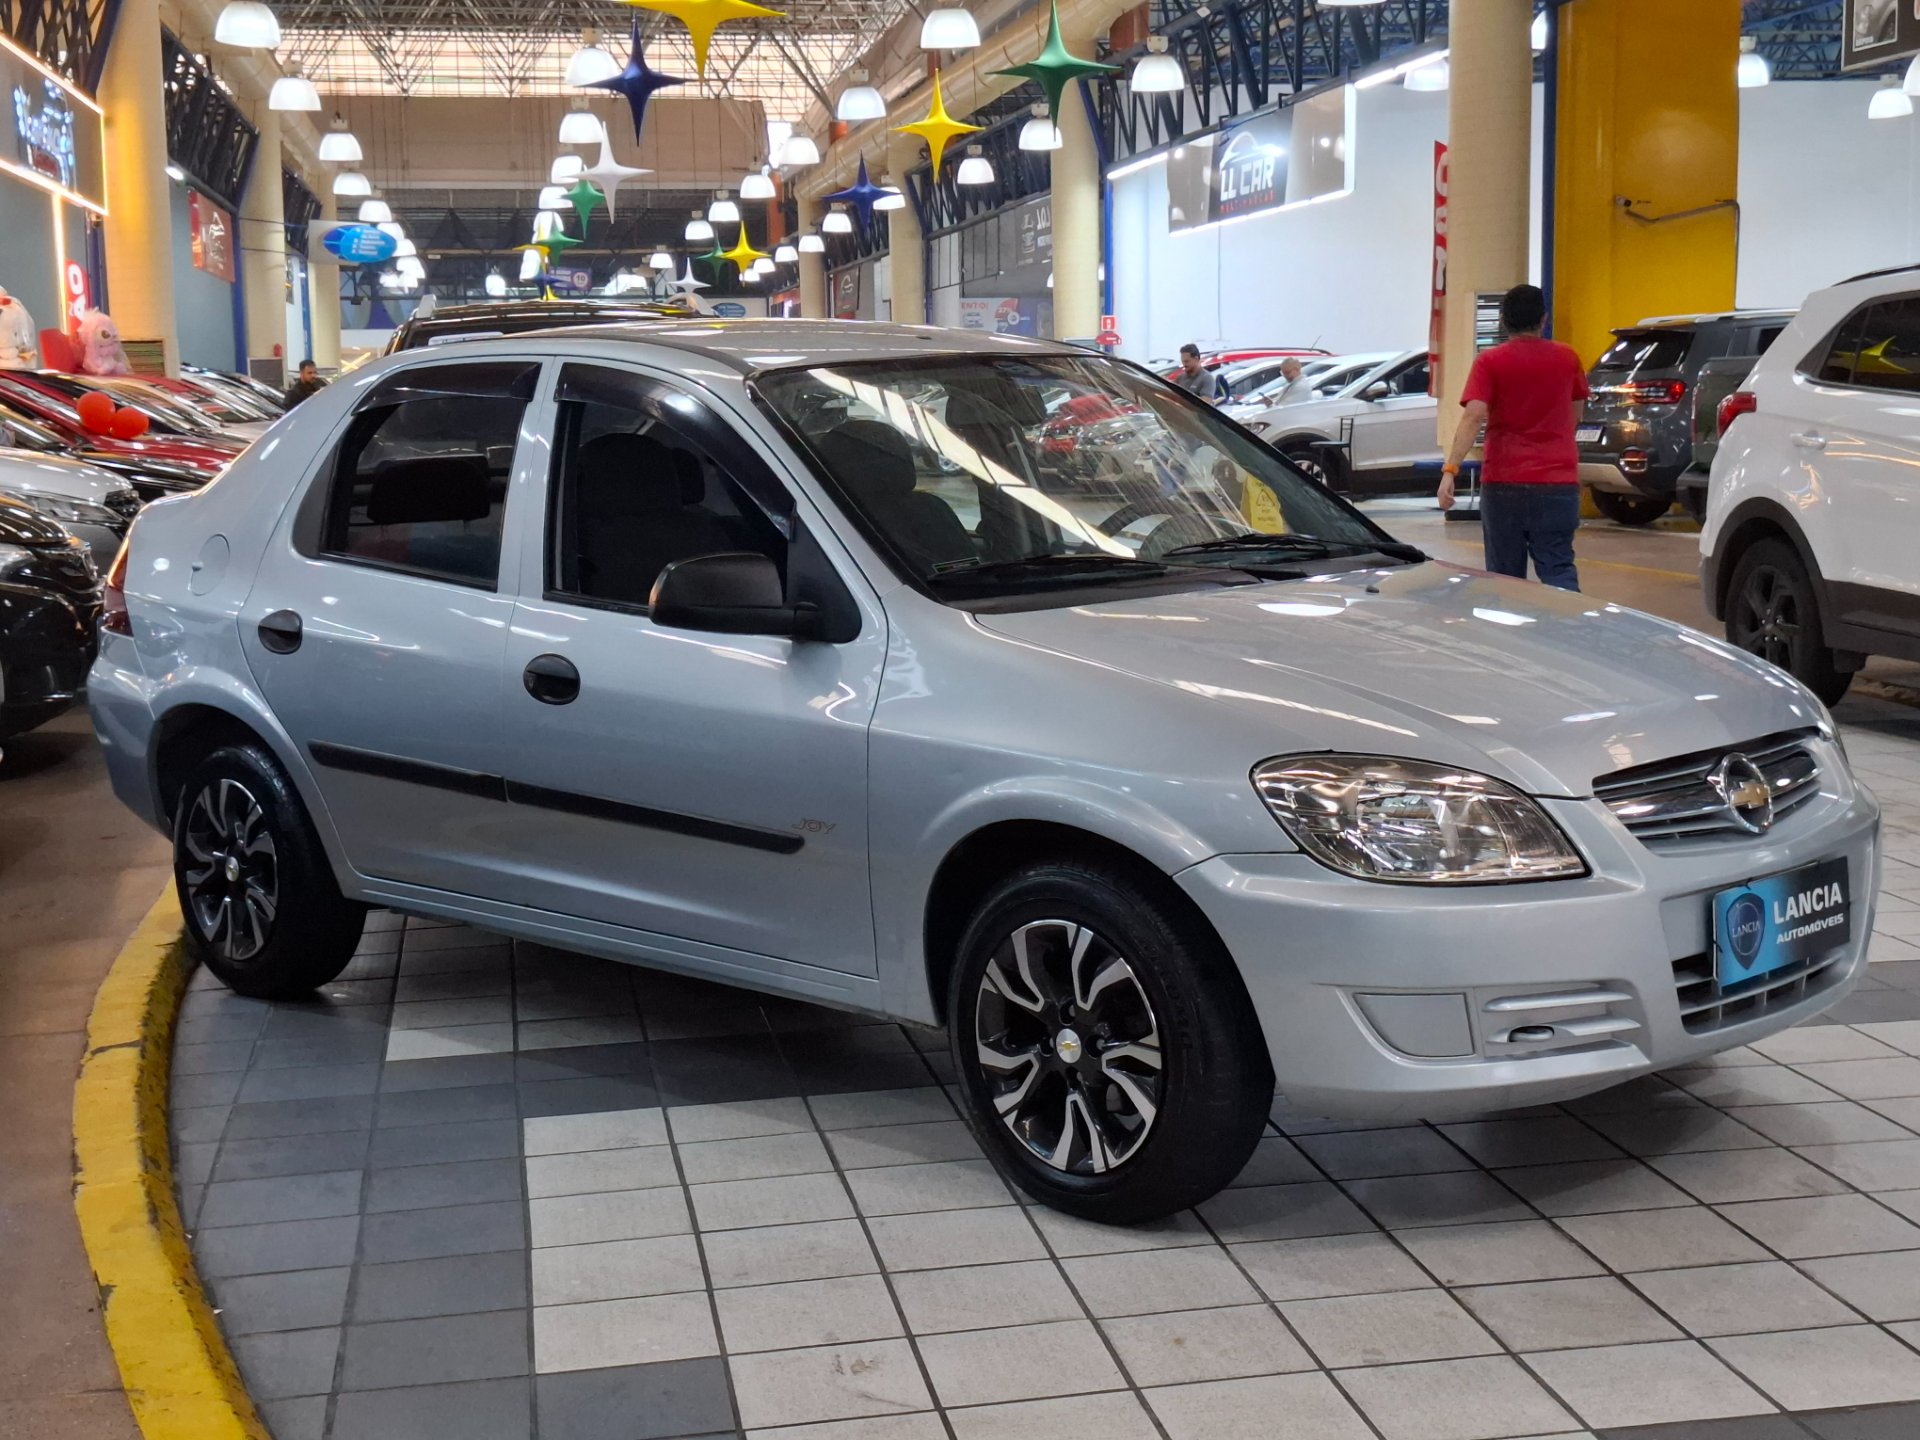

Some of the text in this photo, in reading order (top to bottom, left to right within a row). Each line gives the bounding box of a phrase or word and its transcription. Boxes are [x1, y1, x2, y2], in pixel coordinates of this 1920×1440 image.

[1240, 156, 1276, 196] CAR
[791, 818, 836, 834] JOY
[1773, 882, 1843, 925] LANCIA
[1731, 920, 1761, 938] LANCIA
[1776, 913, 1844, 944] AUTOMÓVEIS
